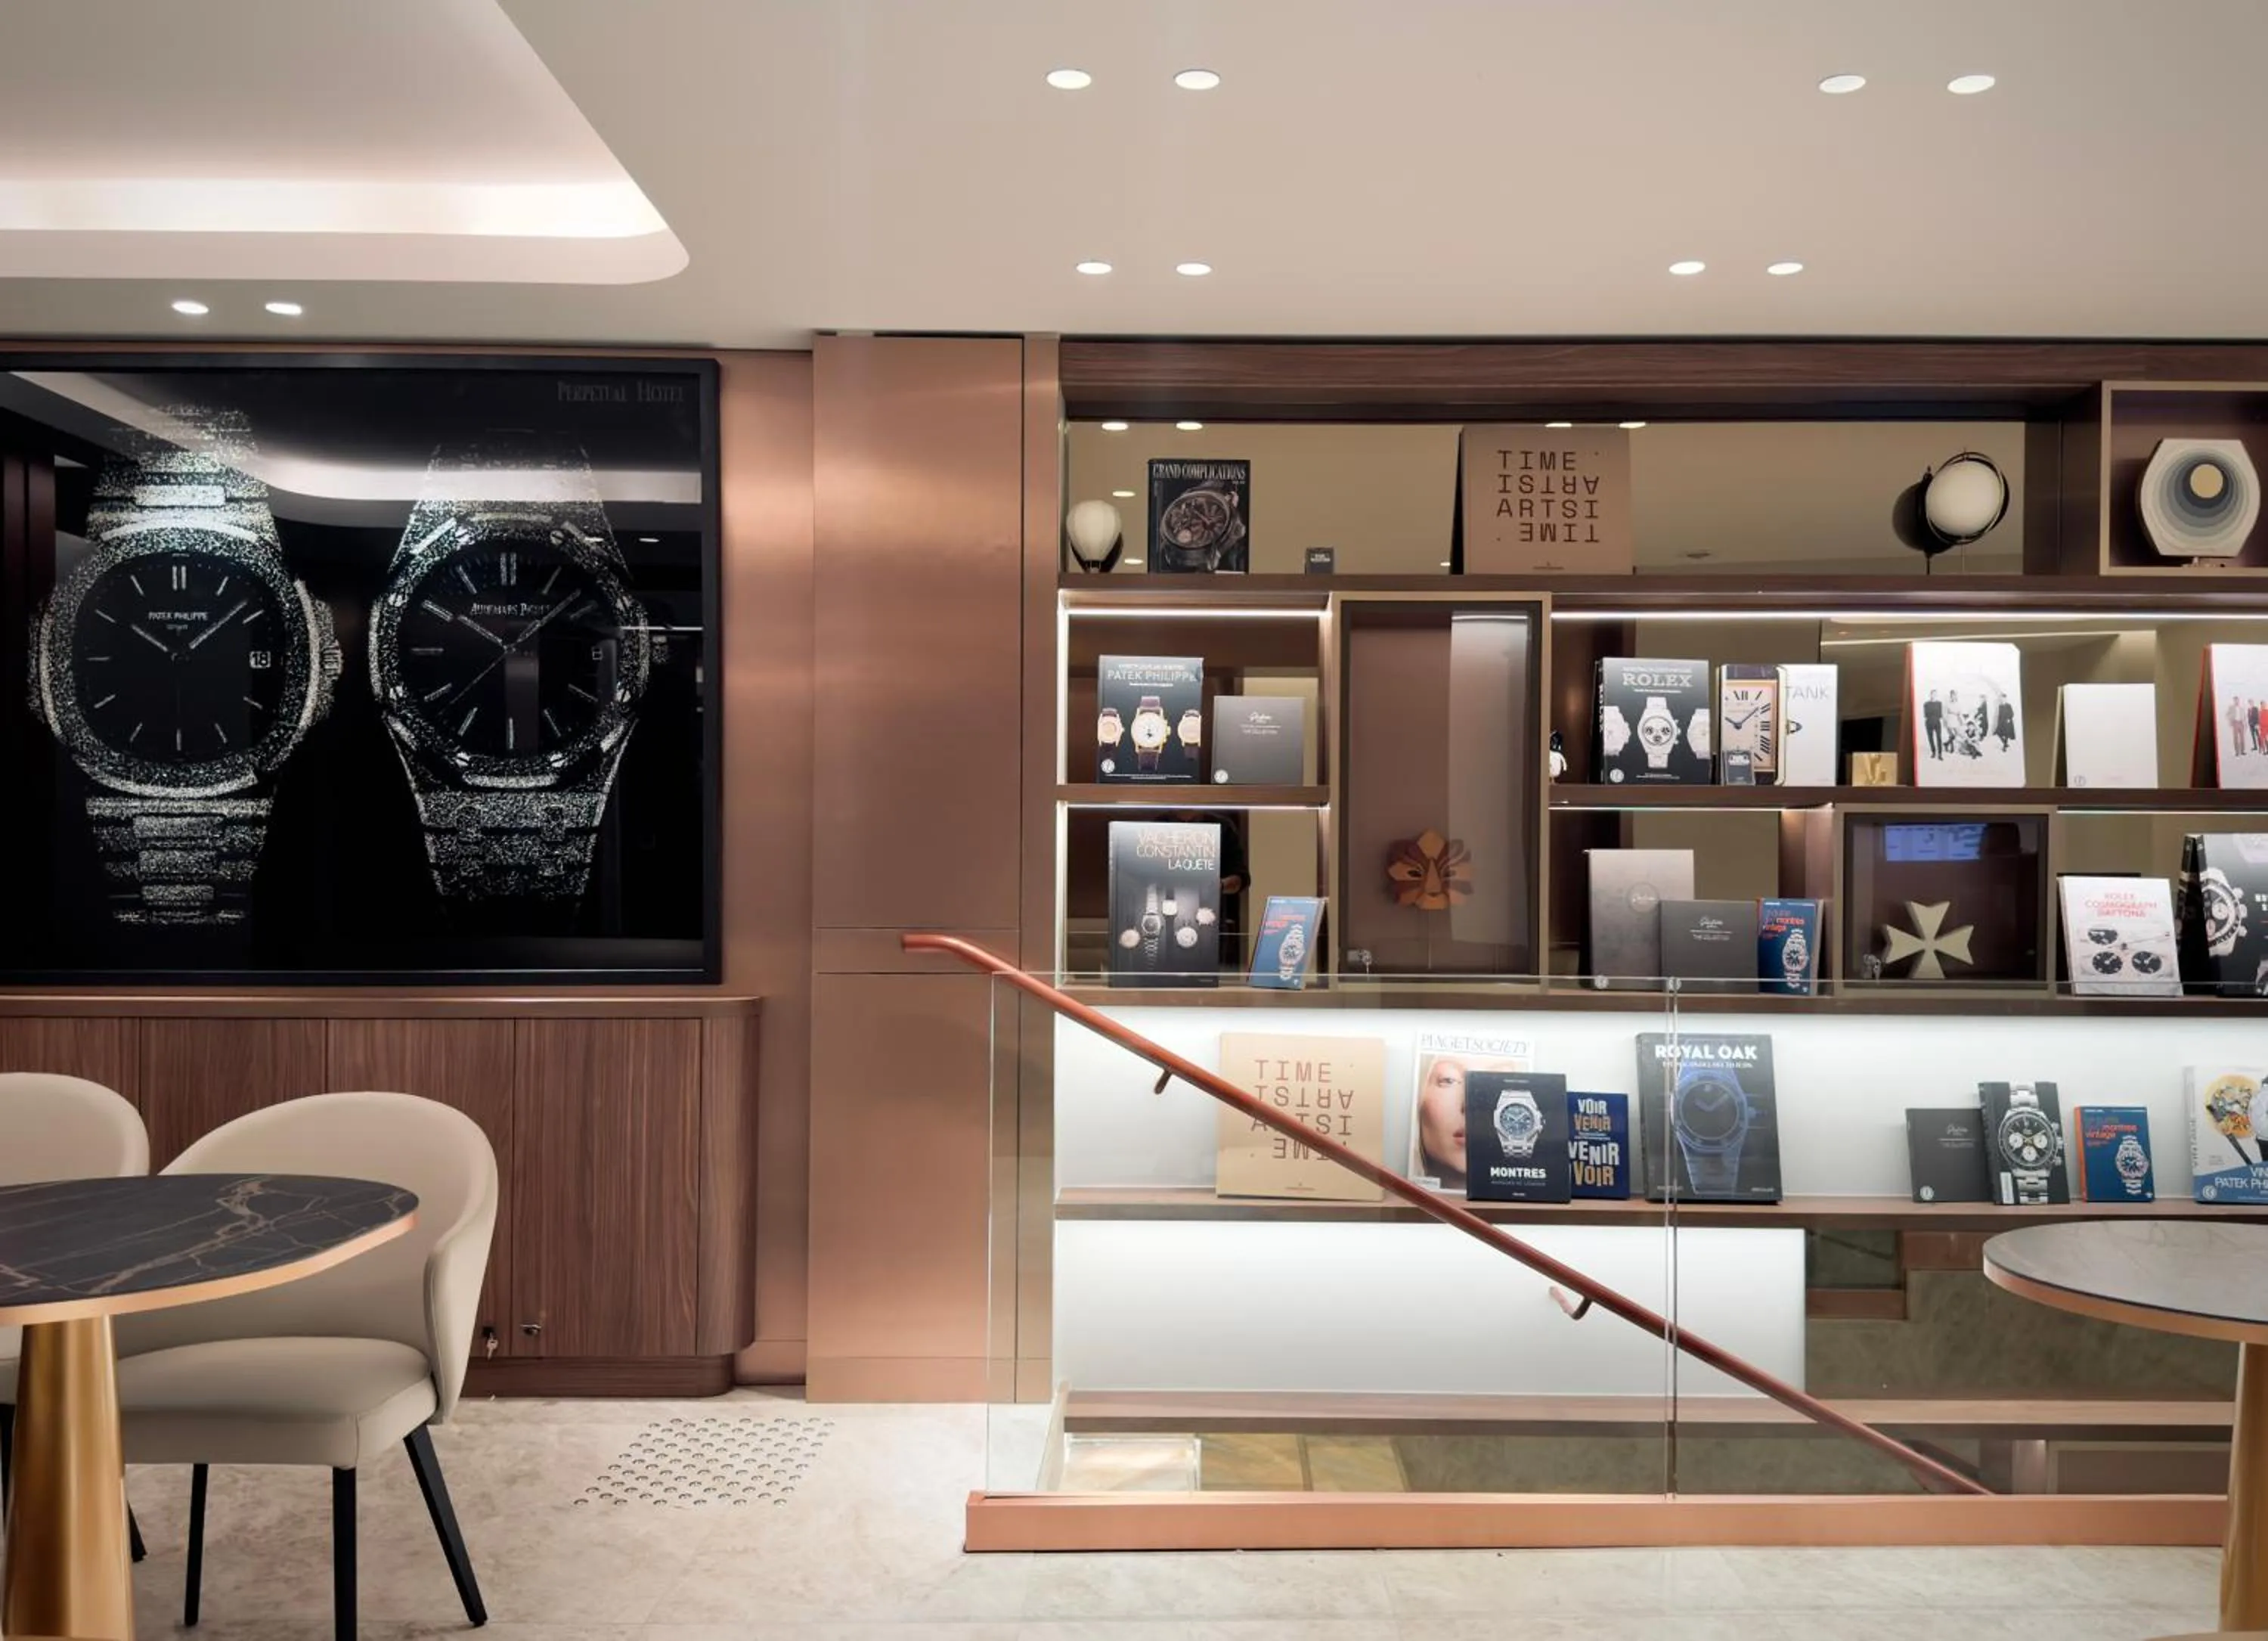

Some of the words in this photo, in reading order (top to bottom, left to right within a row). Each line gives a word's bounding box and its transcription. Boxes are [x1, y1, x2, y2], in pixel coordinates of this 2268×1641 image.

[1497, 450, 1577, 470] TIME
[1153, 464, 1180, 478] GRAND
[1182, 464, 1247, 479] COMPLICATIONS
[1108, 670, 1143, 681] PATEK
[1145, 670, 1199, 682] PHILIPPE
[1622, 672, 1693, 687] ROLEX
[1137, 829, 1216, 845] VACHERON
[1136, 845, 1216, 858] CONSTANTIN
[1655, 1044, 1715, 1059] ROYAL
[1717, 1044, 1758, 1059] OAK
[1254, 1059, 1333, 1083] TIME
[1577, 1098, 1607, 1115] VOIR
[1574, 1112, 1612, 1132] VENIR
[1568, 1140, 1619, 1165] VENIR
[1490, 1167, 1547, 1179] MONTRES
[1573, 1160, 1615, 1187] VOIR
[2214, 1177, 2249, 1188] PATEK
